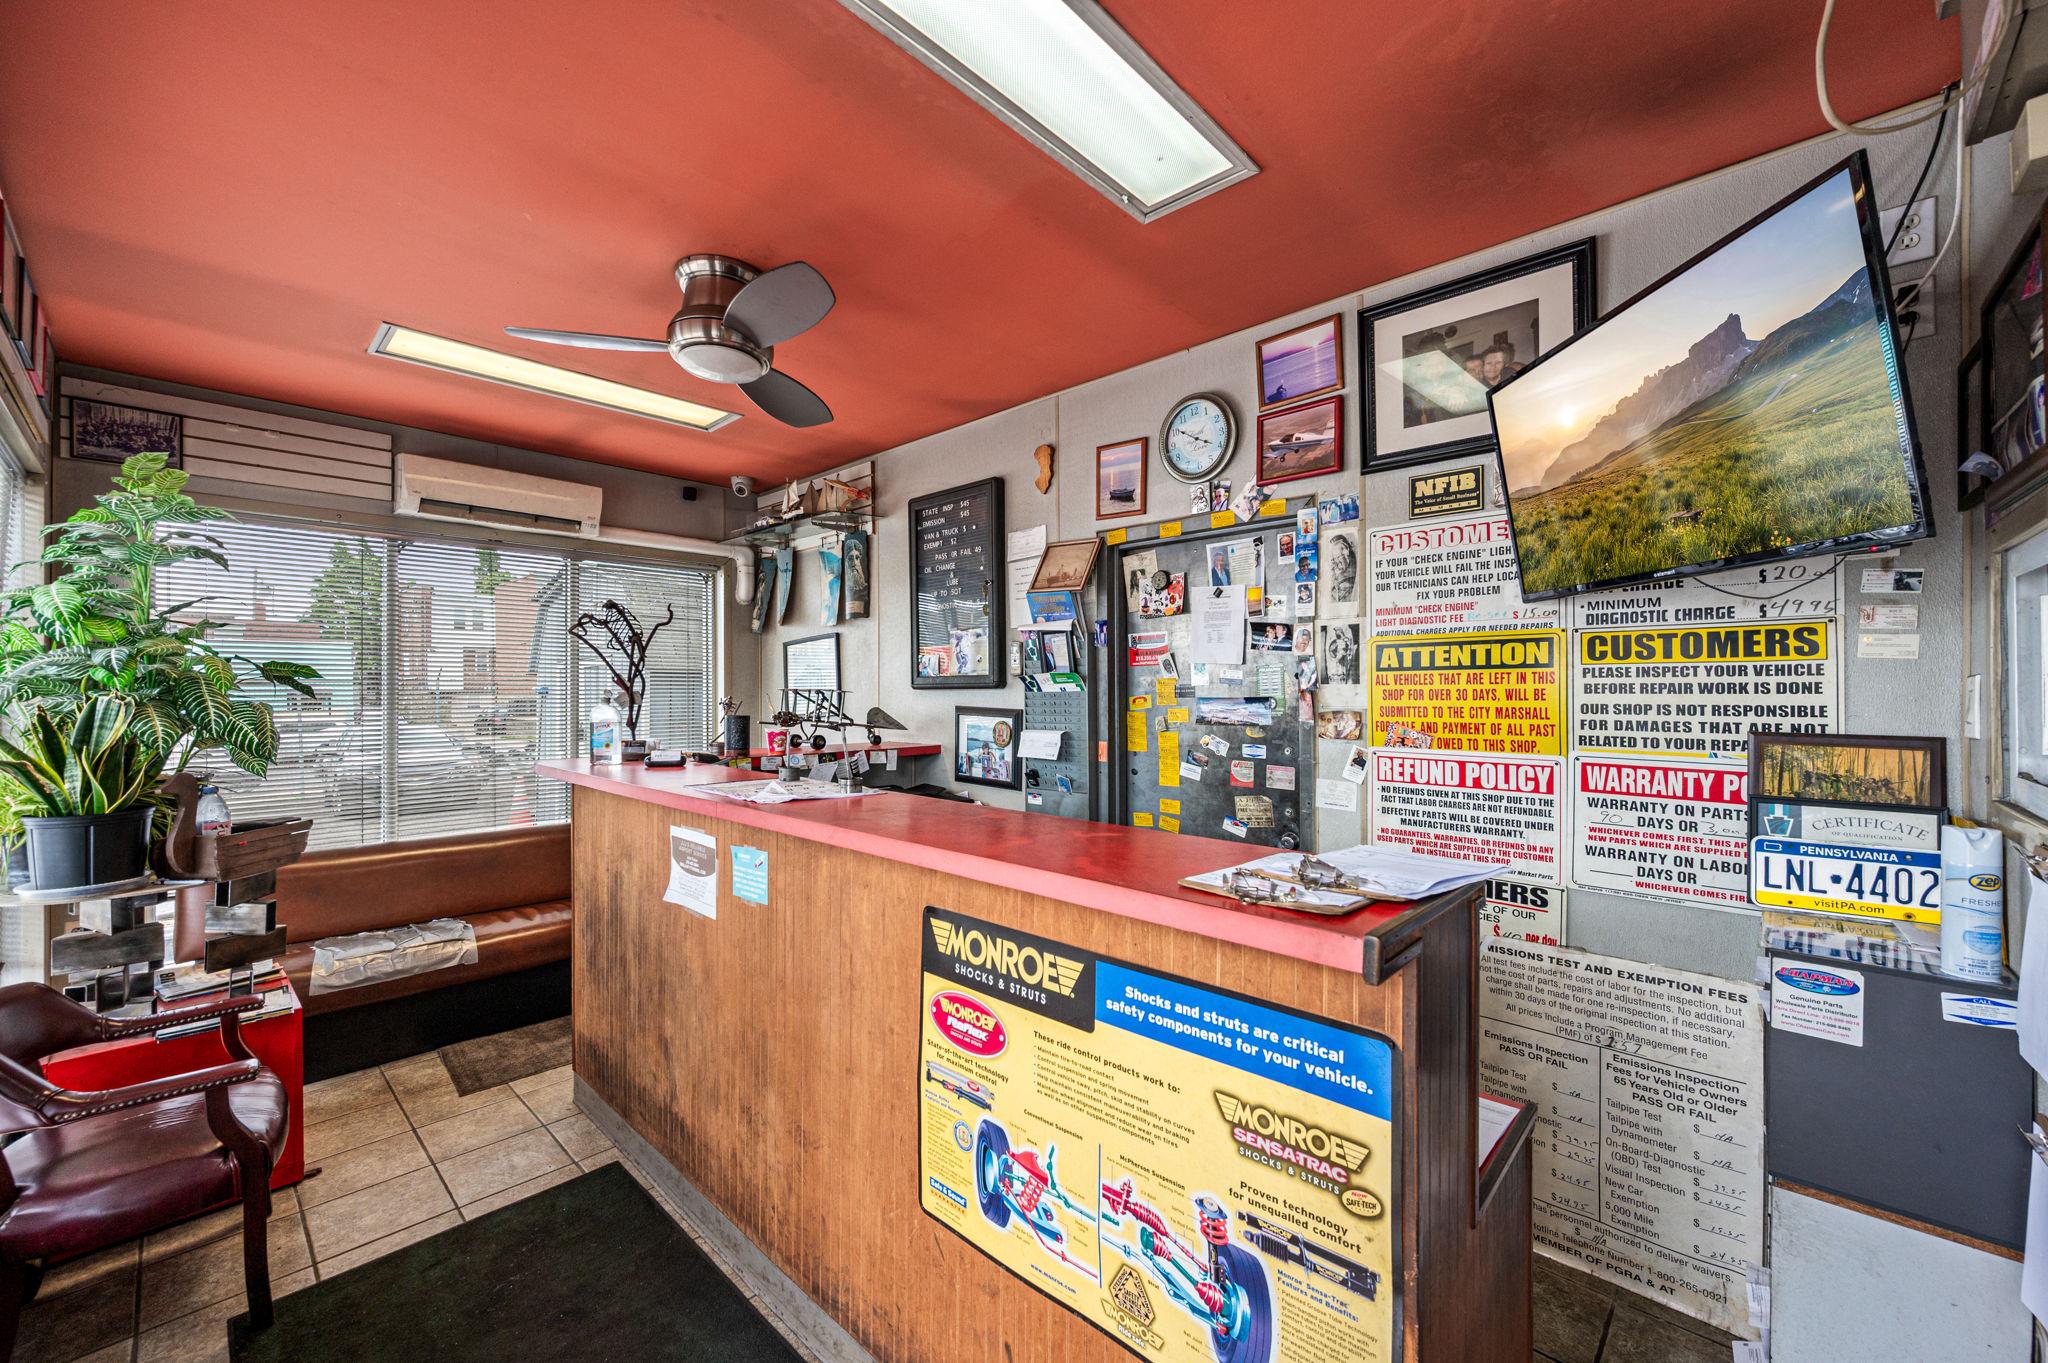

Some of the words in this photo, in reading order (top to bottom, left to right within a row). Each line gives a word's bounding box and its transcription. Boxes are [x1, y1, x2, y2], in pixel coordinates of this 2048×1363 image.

[1415, 473, 1476, 497] NFIB
[923, 508, 938, 517] STATE
[943, 504, 953, 512] INSP
[960, 500, 970, 508] $45
[923, 518, 945, 528] EMISSION
[960, 510, 970, 518] $45
[942, 527, 958, 536] TRUCK
[924, 540, 943, 550] EXEMPT
[936, 562, 955, 571] CHANGE
[1386, 555, 1408, 567] YOUR
[1411, 552, 1443, 565] "CHECK
[1447, 549, 1486, 561] ENGINE"
[1376, 606, 1413, 616] MINIMUM
[1415, 604, 1442, 614] "CHECK
[1445, 602, 1478, 611] ENGINE"
[1586, 609, 1668, 626] DIAGNOSTIC
[1675, 605, 1735, 620] CHARGE
[1759, 603, 1767, 618] $
[1587, 597, 1661, 611] MINIMUM
[1376, 617, 1396, 627] LIGHT
[1400, 615, 1447, 625] DIAGNOSTIC
[1450, 614, 1464, 623] FEE
[1512, 610, 1518, 619] $
[1586, 626, 1820, 661] CUSTOMERS
[1379, 641, 1549, 668] ATTENTION
[1376, 675, 1390, 685] ALL
[1393, 674, 1434, 685] VEHICLES
[1439, 673, 1462, 685] THAT
[1466, 672, 1484, 685] ARE
[1489, 672, 1511, 684] LEFT
[1516, 672, 1527, 684] IN
[1532, 671, 1556, 684] THIS
[1582, 666, 1632, 679] PLEASE
[1636, 665, 1700, 678] INSPECT
[1704, 665, 1749, 678] YOUR
[1752, 664, 1825, 677] VEHICLE
[1382, 689, 1404, 701] SHOP
[1408, 689, 1424, 701] FOR
[1428, 689, 1451, 701] OVER
[1455, 689, 1468, 701] 30
[1505, 688, 1530, 701] WILL
[1534, 688, 1546, 701] BE
[1584, 682, 1636, 695] BEFORE
[1640, 682, 1694, 695] REPAIR
[1698, 682, 1749, 695] WORK
[1754, 682, 1768, 694] IS
[1772, 682, 1823, 694] DONE
[1378, 758, 1460, 786] REFUND
[1465, 762, 1551, 793] POLICY
[1586, 765, 1716, 799] WARRANTY
[1393, 786, 1425, 796] REFUNDS
[1427, 789, 1449, 798] GIVEN
[1451, 791, 1460, 799] AT
[1462, 792, 1480, 801] THIS
[1482, 793, 1504, 803] SHOP
[1507, 795, 1523, 805] DUE
[1525, 797, 1536, 806] TO
[1538, 798, 1554, 807] THE
[1588, 797, 1669, 815] WARRANTY
[1674, 804, 1695, 817] ON
[1600, 811, 1622, 823] 90
[1638, 816, 1673, 830] DAYS
[1679, 820, 1698, 832] OR
[1400, 818, 1471, 833] MANUFACTURERS
[1473, 825, 1526, 839] WARRANTY.
[1589, 826, 1640, 838] WHICHEVER
[1642, 832, 1674, 842] COMES
[1812, 816, 1929, 841] CERTIFICATE
[1843, 832, 1903, 841] QUALIFICATION
[1800, 845, 1898, 862] PENNSYLVANIA
[1814, 900, 1885, 914] visitPA.com
[938, 920, 1073, 996] MONROE
[955, 963, 993, 985] SHOCKS
[999, 979, 1005, 989] &
[1009, 983, 1046, 1004] STRUTS
[1548, 956, 1580, 969] TEST
[1585, 964, 1612, 975] AND
[1617, 970, 1703, 994] EXEMPTION
[1709, 988, 1748, 1004] FEES
[1779, 967, 1855, 988] CHAPMAN
[1776, 999, 1806, 1009] Wholesale
[1825, 1008, 1858, 1019] Distributor
[1790, 994, 1821, 1005] Genuine
[1823, 1000, 1843, 1009] Parts
[1125, 985, 1171, 1010] Shocks
[1175, 1002, 1200, 1019] and
[1203, 1012, 1250, 1034] struts
[1253, 1026, 1279, 1043] are
[1283, 1036, 1345, 1064] critical
[1106, 998, 1145, 1022] safety
[1148, 1012, 1232, 1048] components
[1235, 1038, 1259, 1056] for
[1263, 1047, 1300, 1070] your
[1304, 1059, 1374, 1095] vehicle.
[1034, 1030, 1054, 1045] These
[1057, 1040, 1071, 1051] ride
[1073, 1047, 1101, 1063] control
[1104, 1058, 1140, 1079] products
[1143, 1073, 1164, 1088] work
[1168, 1083, 1181, 1094] to:
[1613, 1054, 1671, 1077] Emissions
[1675, 1071, 1739, 1094] Inspection
[1606, 1063, 1632, 1077] Fees
[1635, 1071, 1651, 1082] for
[1653, 1076, 1695, 1094] Vehicle
[1700, 1088, 1747, 1107] Owners
[1614, 1076, 1626, 1086] 65
[1629, 1080, 1659, 1096] Years
[1663, 1090, 1683, 1101] Old
[1688, 1097, 1699, 1106] or
[1703, 1102, 1738, 1116] Older
[1632, 1092, 1663, 1108] PASS
[1667, 1103, 1685, 1114] OR
[1689, 1110, 1716, 1123] FAIL
[1224, 1096, 1359, 1169] MONROE
[1240, 1181, 1279, 1205] Proven
[1283, 1199, 1348, 1236] technology
[1606, 1263, 1642, 1283] PGRA
[1646, 1279, 1655, 1288] &
[1659, 1284, 1676, 1296] AT
